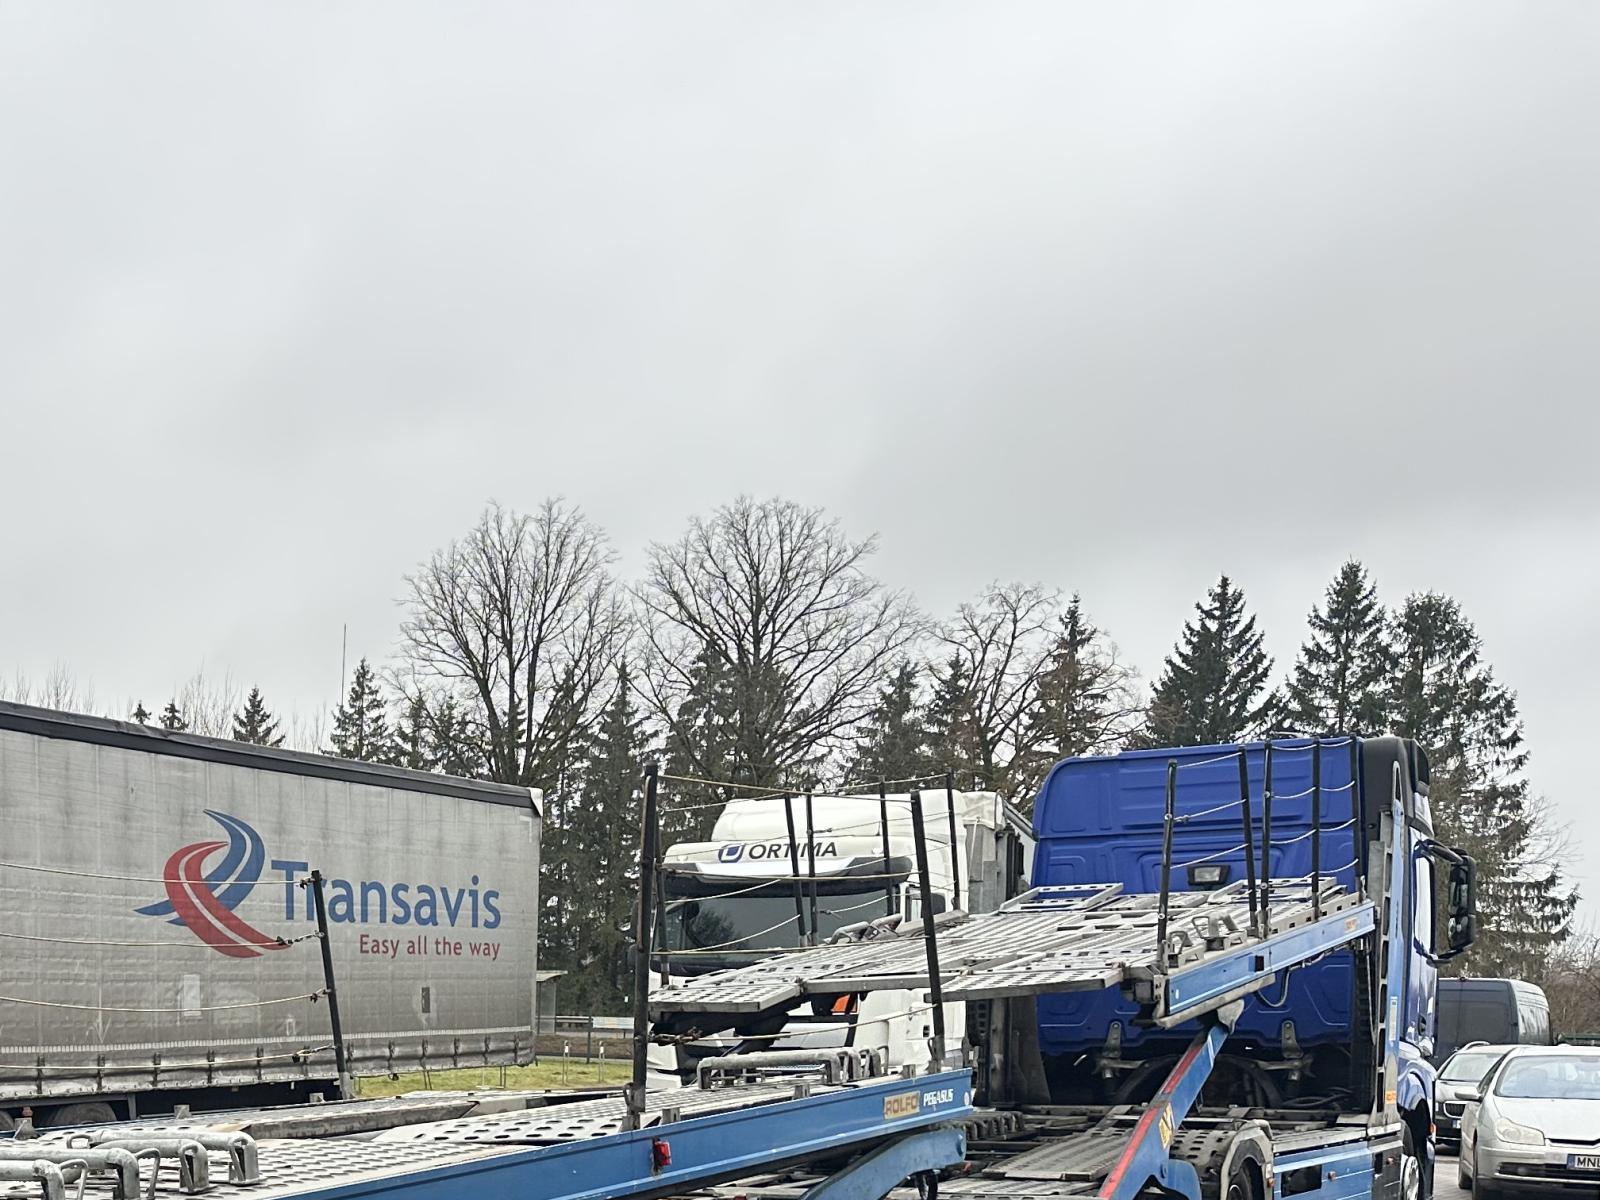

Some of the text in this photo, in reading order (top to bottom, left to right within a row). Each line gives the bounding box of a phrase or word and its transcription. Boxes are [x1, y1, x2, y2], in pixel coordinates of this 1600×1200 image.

[271, 860, 502, 929] Transavis
[359, 934, 500, 961] Easy all the way
[885, 1089, 954, 1115] ROLFO PEGASUS
